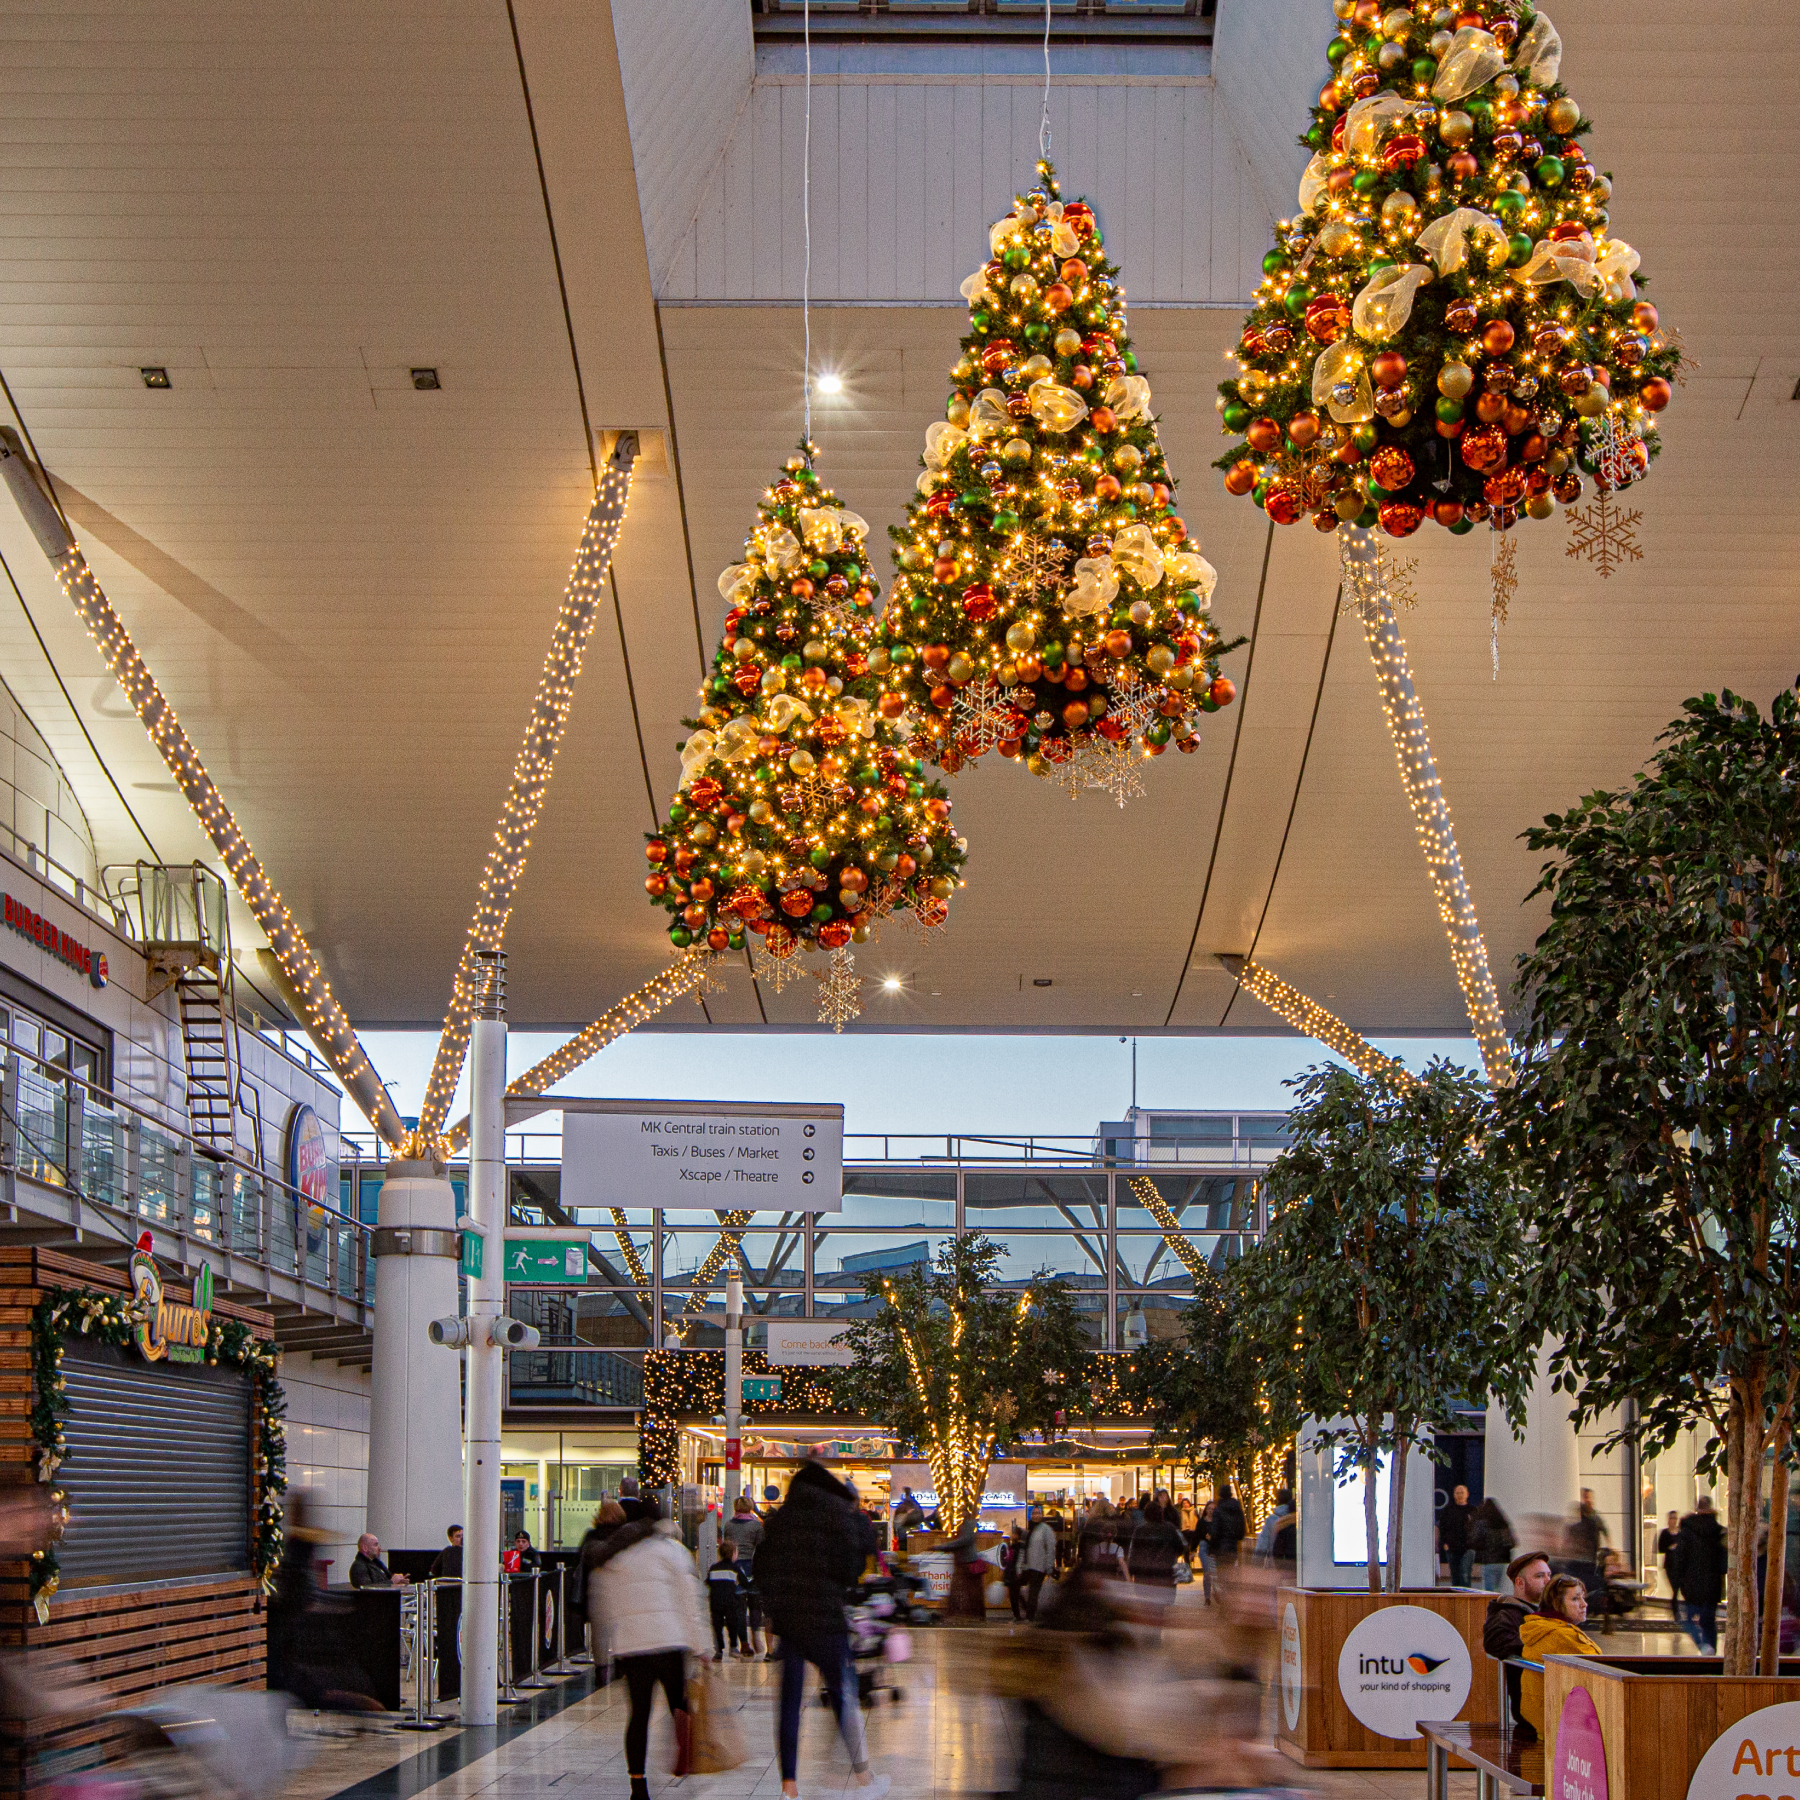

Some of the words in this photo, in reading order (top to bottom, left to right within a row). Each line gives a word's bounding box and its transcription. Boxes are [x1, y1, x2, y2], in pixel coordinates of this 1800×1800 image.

[4, 893, 58, 953] BURGER
[61, 931, 91, 974] KING
[641, 1121, 661, 1133] MK
[664, 1122, 706, 1134] Central
[708, 1123, 735, 1135] train
[738, 1124, 780, 1136] station
[651, 1145, 679, 1157] Taxis
[691, 1146, 725, 1158] Buses
[737, 1147, 780, 1159] Market
[679, 1169, 722, 1183] Xscape
[733, 1170, 779, 1182] Theatre
[781, 1339, 807, 1349] Come
[809, 1340, 830, 1349] back
[929, 1582, 950, 1591] visit
[1359, 1653, 1404, 1675] intu
[1360, 1683, 1379, 1692] your
[1381, 1682, 1399, 1691] kind
[1401, 1681, 1410, 1691] of
[1411, 1682, 1451, 1692] shopping
[1567, 1748, 1580, 1773] Join
[1581, 1759, 1592, 1778] our
